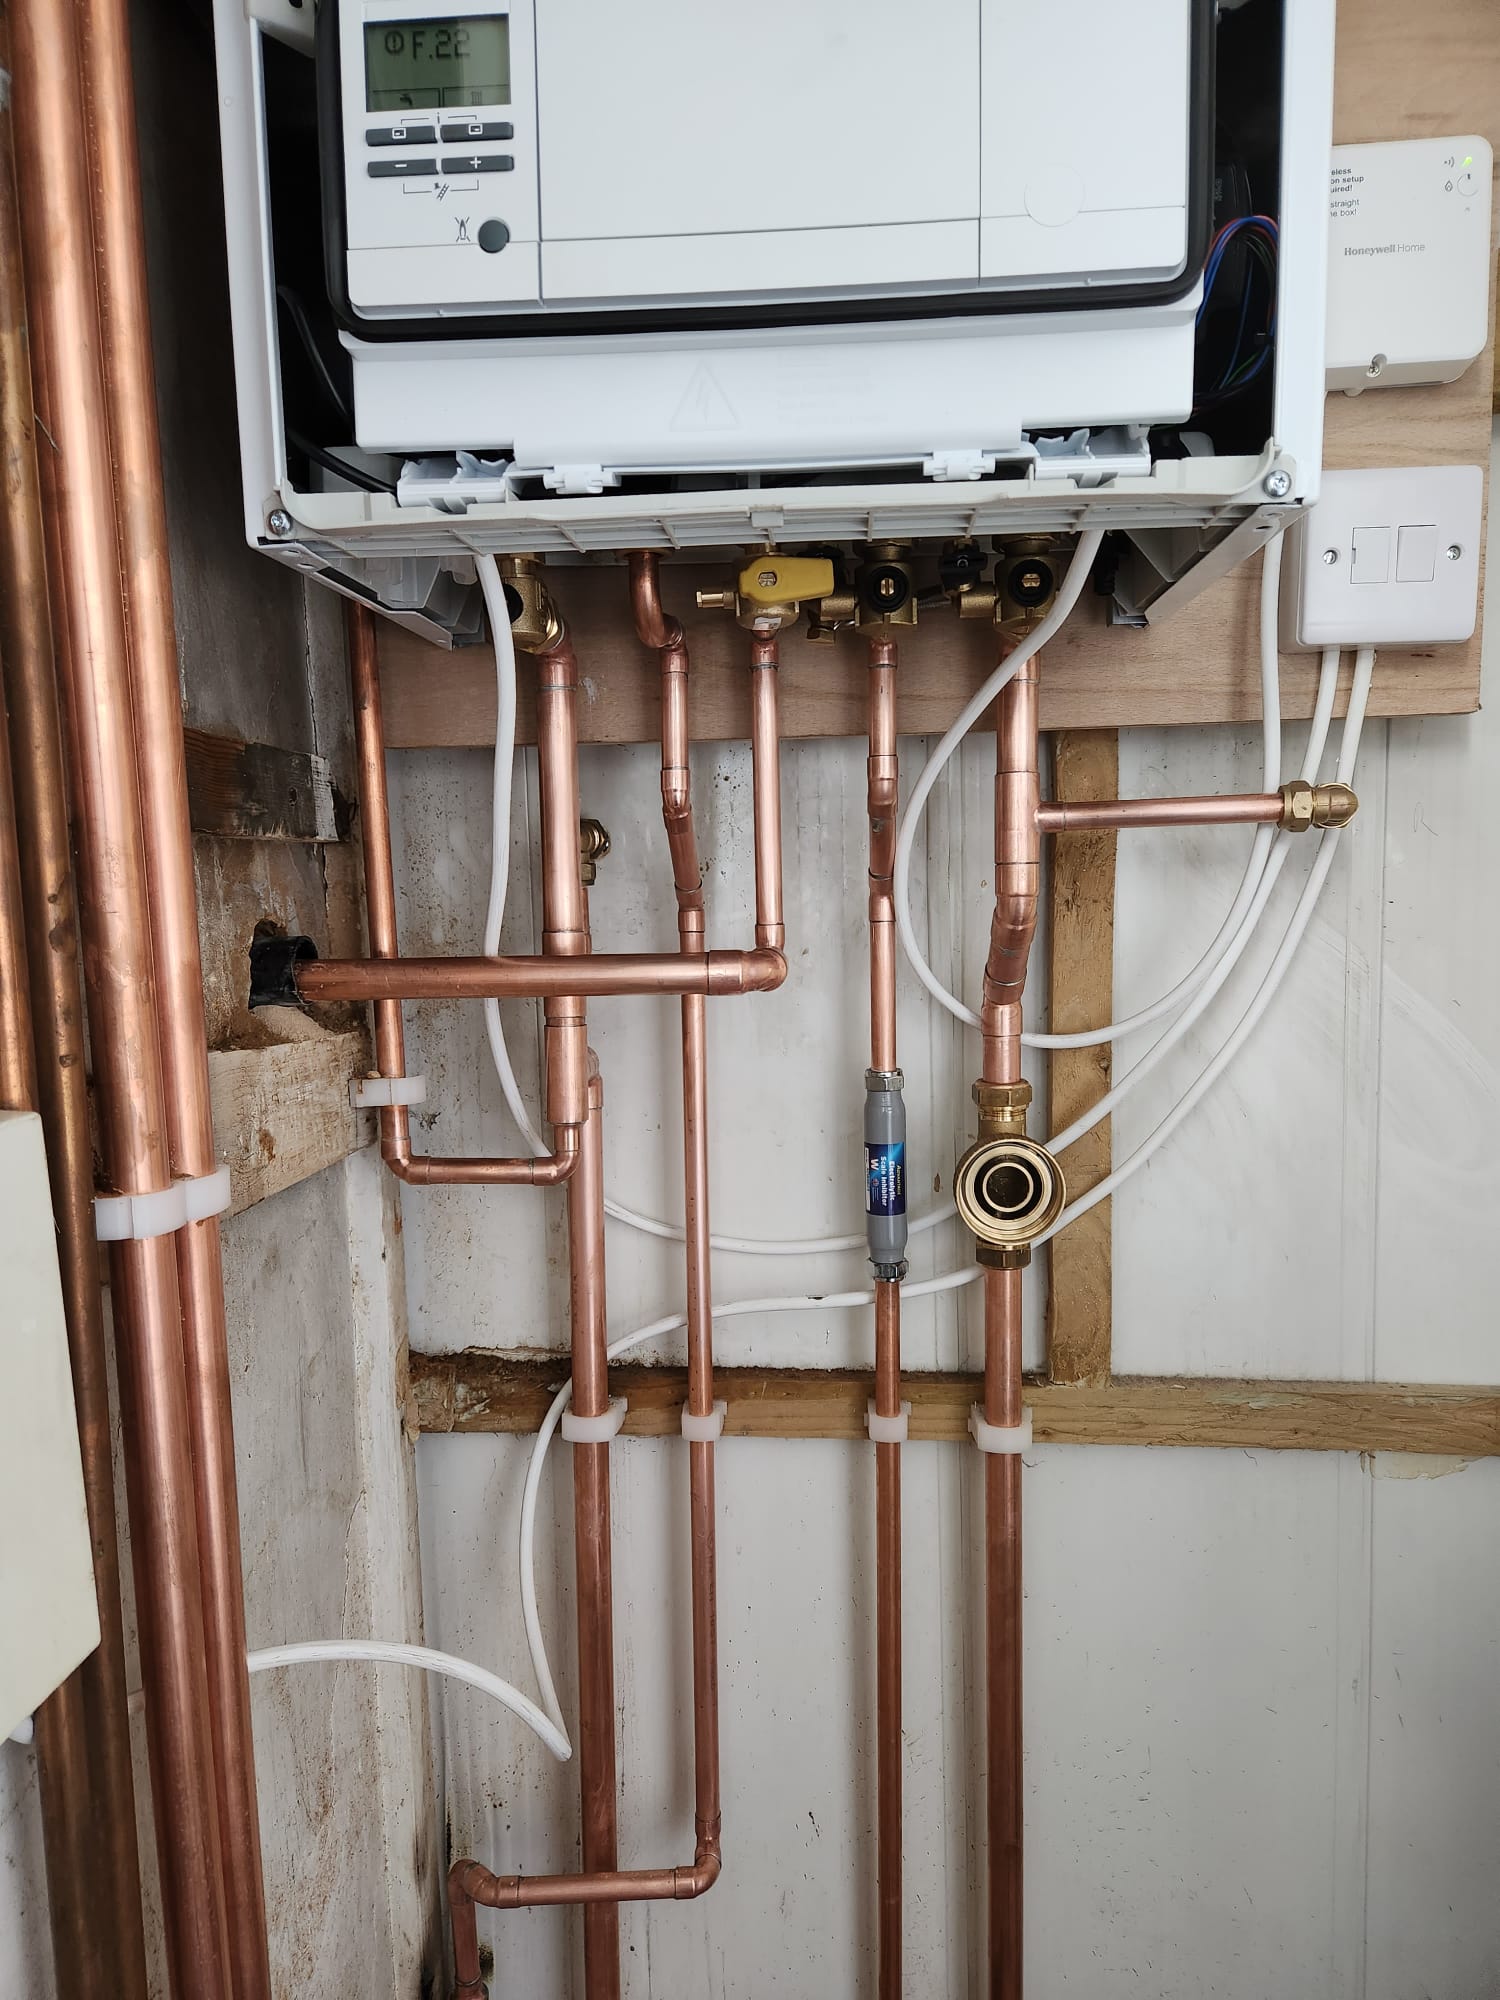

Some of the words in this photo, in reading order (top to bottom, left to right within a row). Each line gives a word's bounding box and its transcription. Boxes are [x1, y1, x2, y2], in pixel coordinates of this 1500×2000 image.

[412, 29, 470, 60] F.22
[1342, 176, 1365, 184] setup
[1330, 199, 1360, 209] straight
[1340, 208, 1357, 217] box!
[1344, 244, 1396, 257] Honeywell
[1397, 243, 1426, 253] Home
